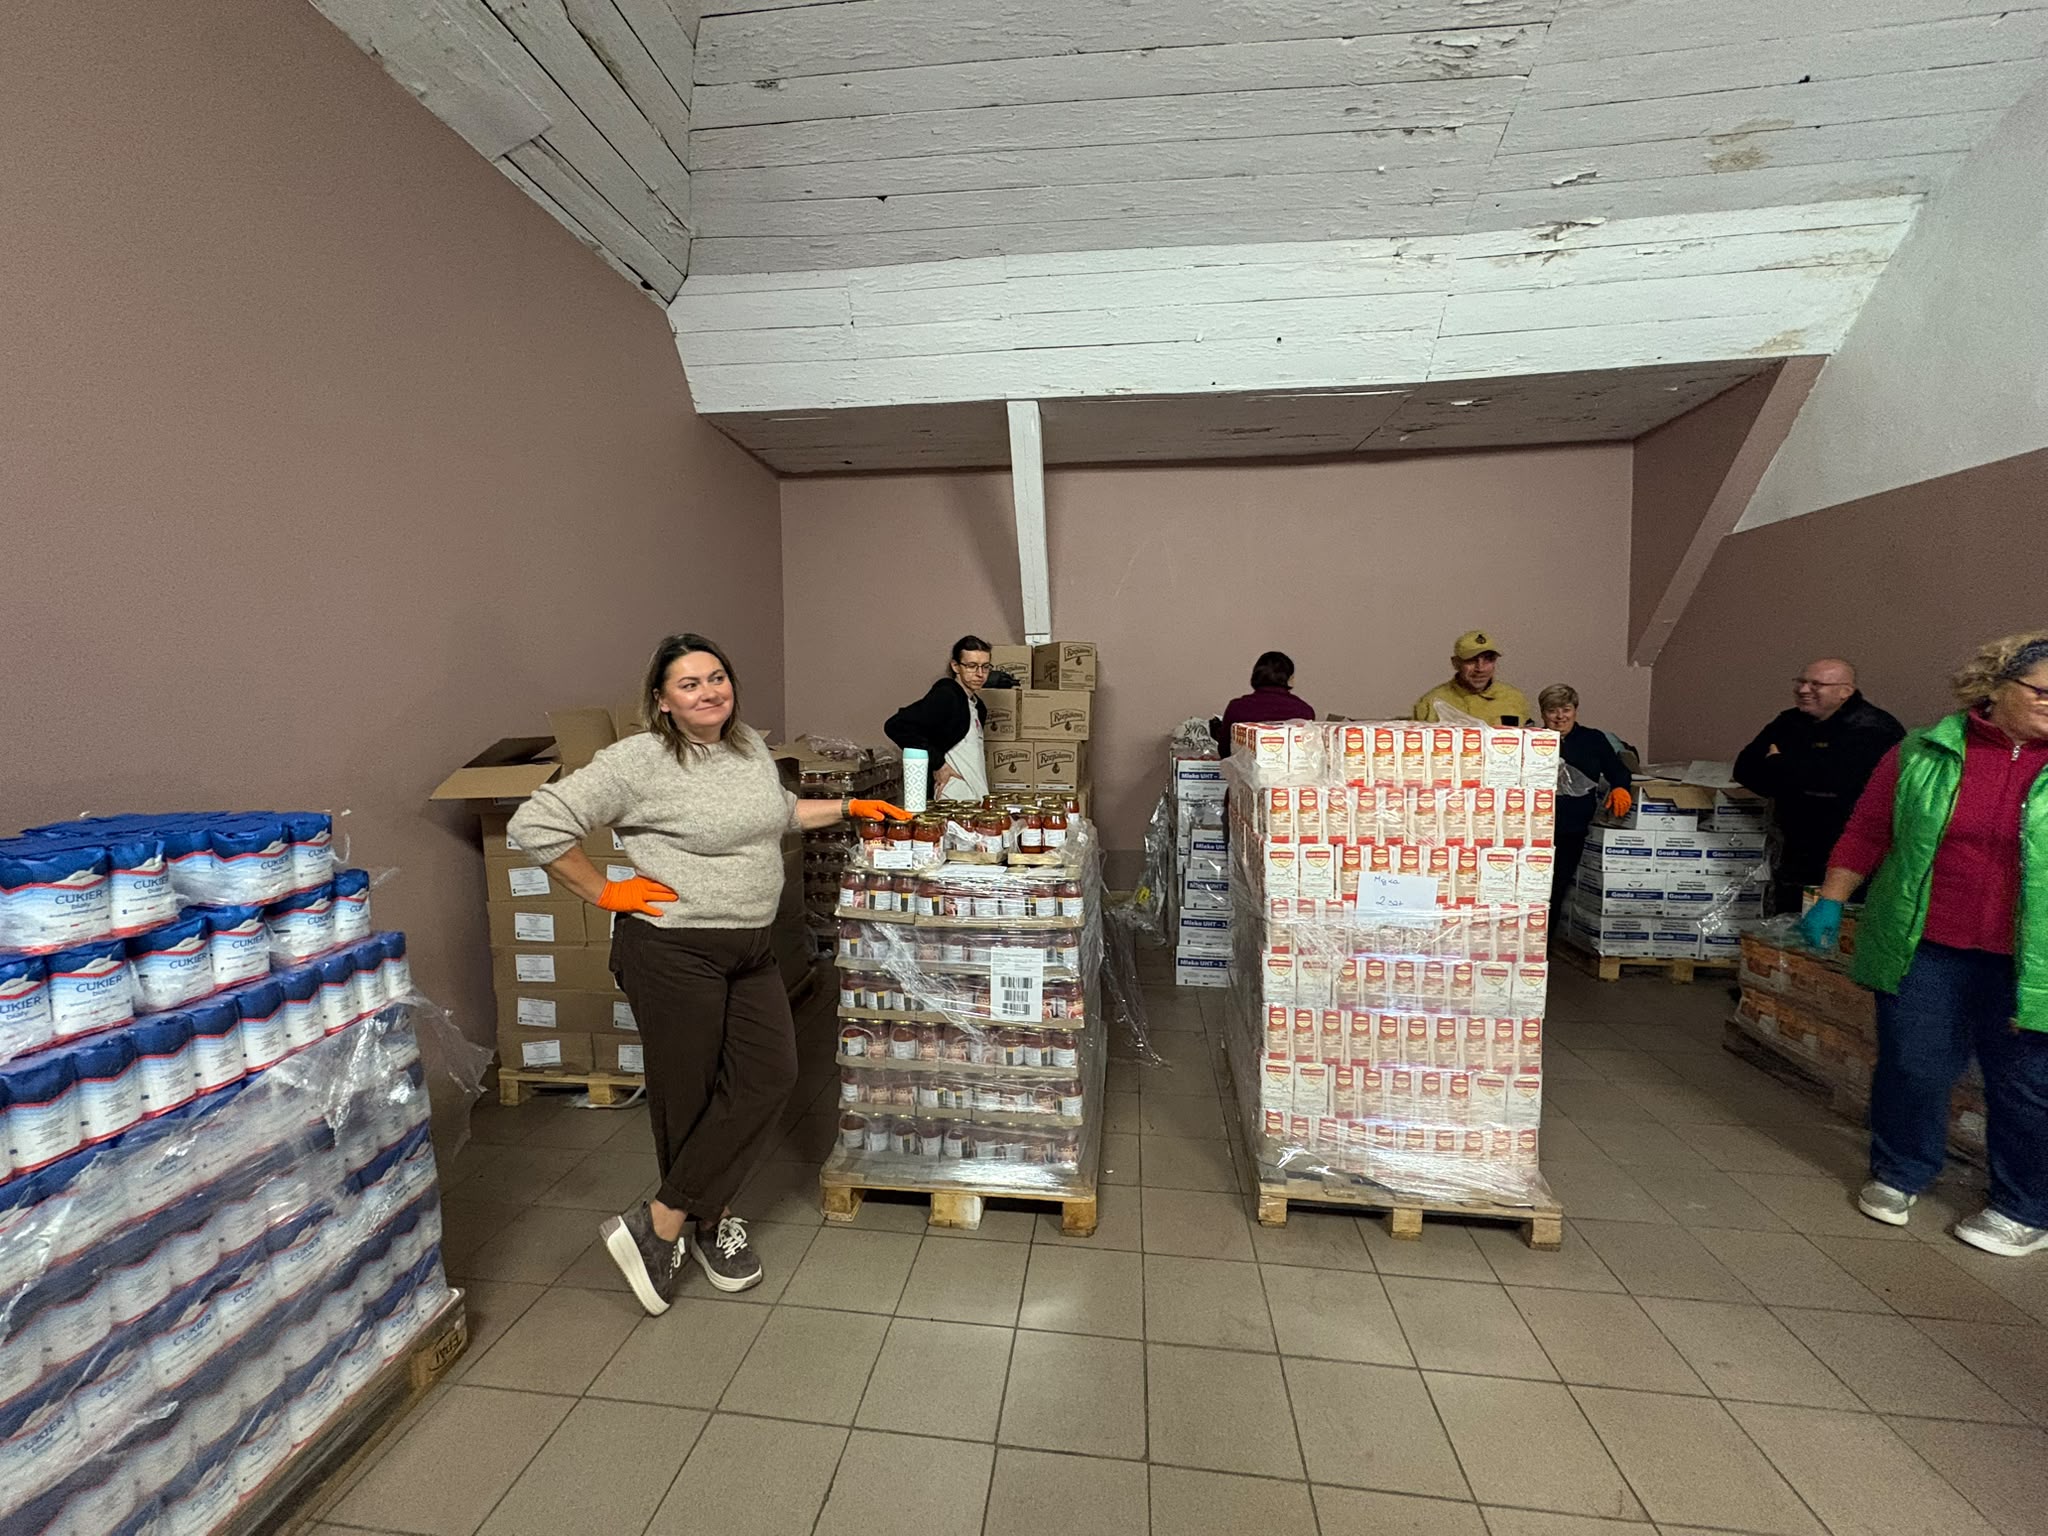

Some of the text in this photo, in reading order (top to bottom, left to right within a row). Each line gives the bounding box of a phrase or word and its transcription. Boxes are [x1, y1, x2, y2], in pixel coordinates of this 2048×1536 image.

[1607, 847, 1630, 855] Gouda
[1658, 849, 1680, 857] Gouda
[55, 889, 104, 905] CUKIER
[169, 952, 208, 970] CUKIER
[76, 974, 122, 993] CUKIER
[0, 996, 41, 1014] UKIER
